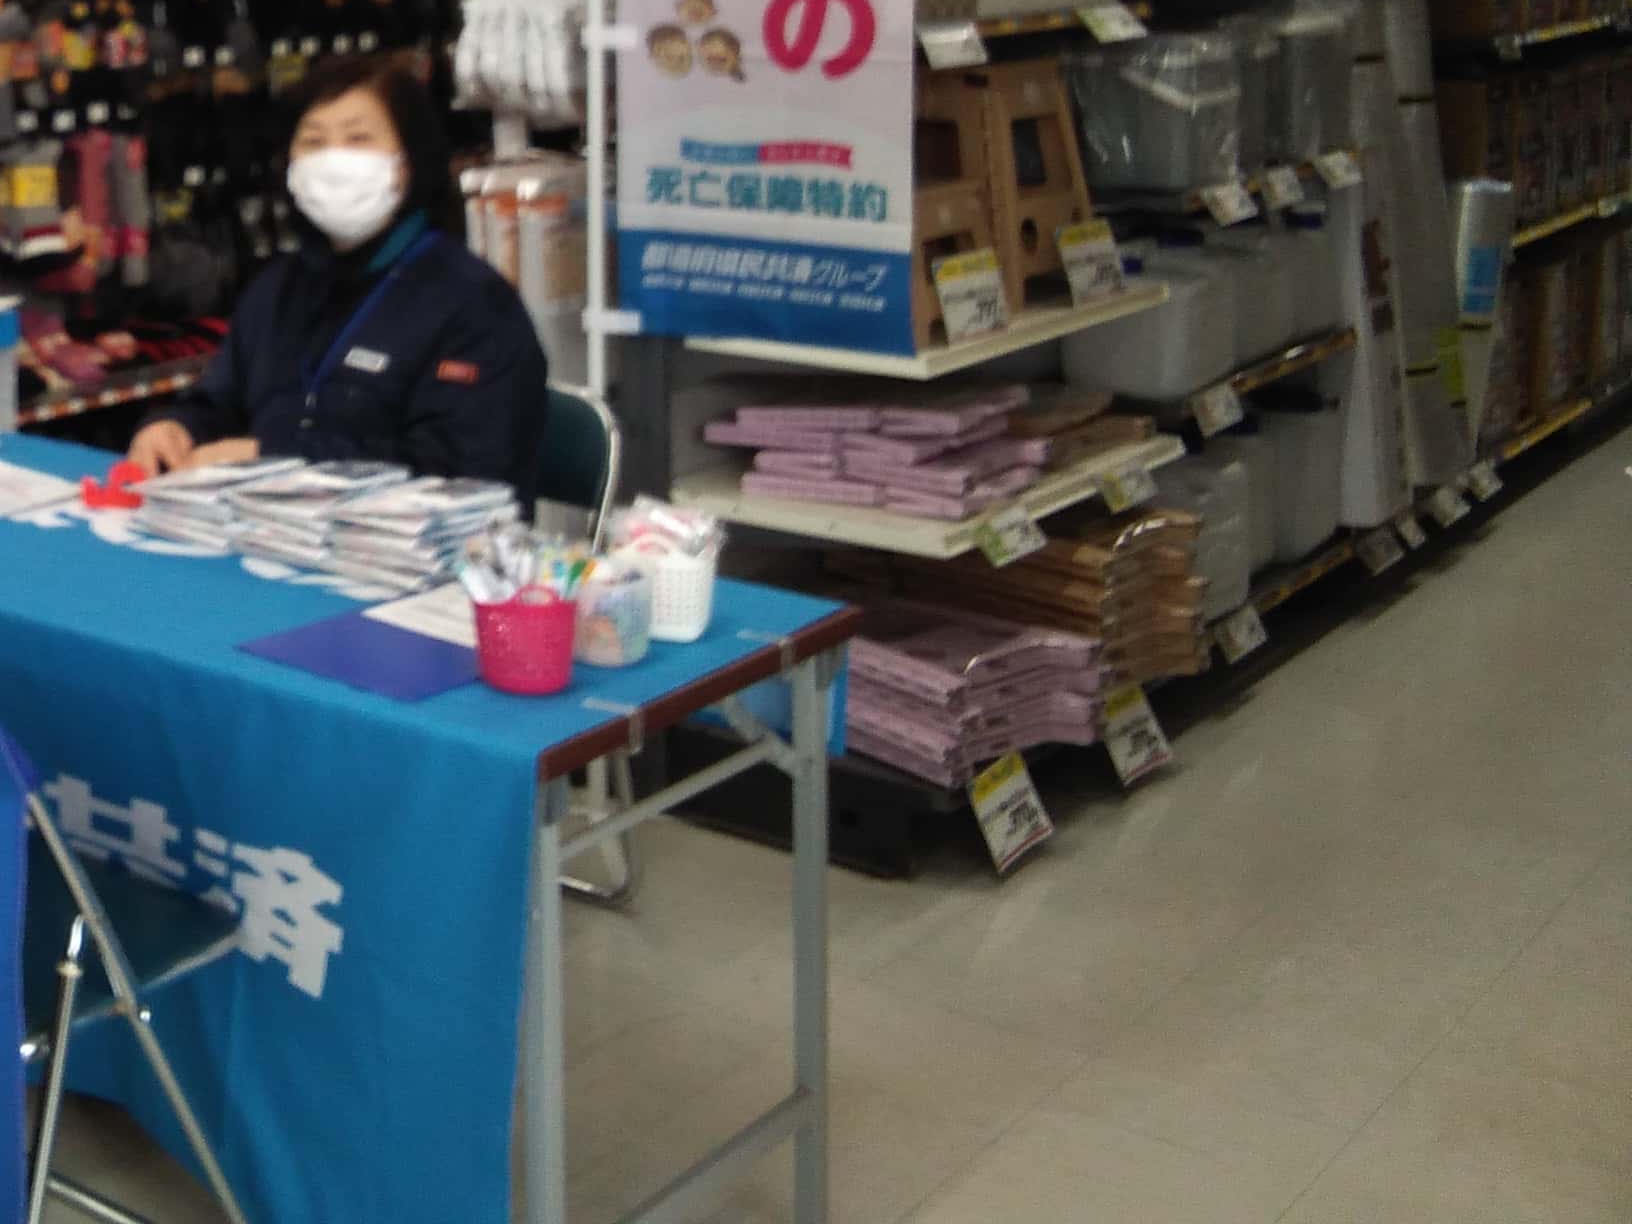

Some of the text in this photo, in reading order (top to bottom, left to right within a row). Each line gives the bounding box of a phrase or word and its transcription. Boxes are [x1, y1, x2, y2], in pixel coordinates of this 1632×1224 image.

[645, 166, 888, 223] 死亡保障特約
